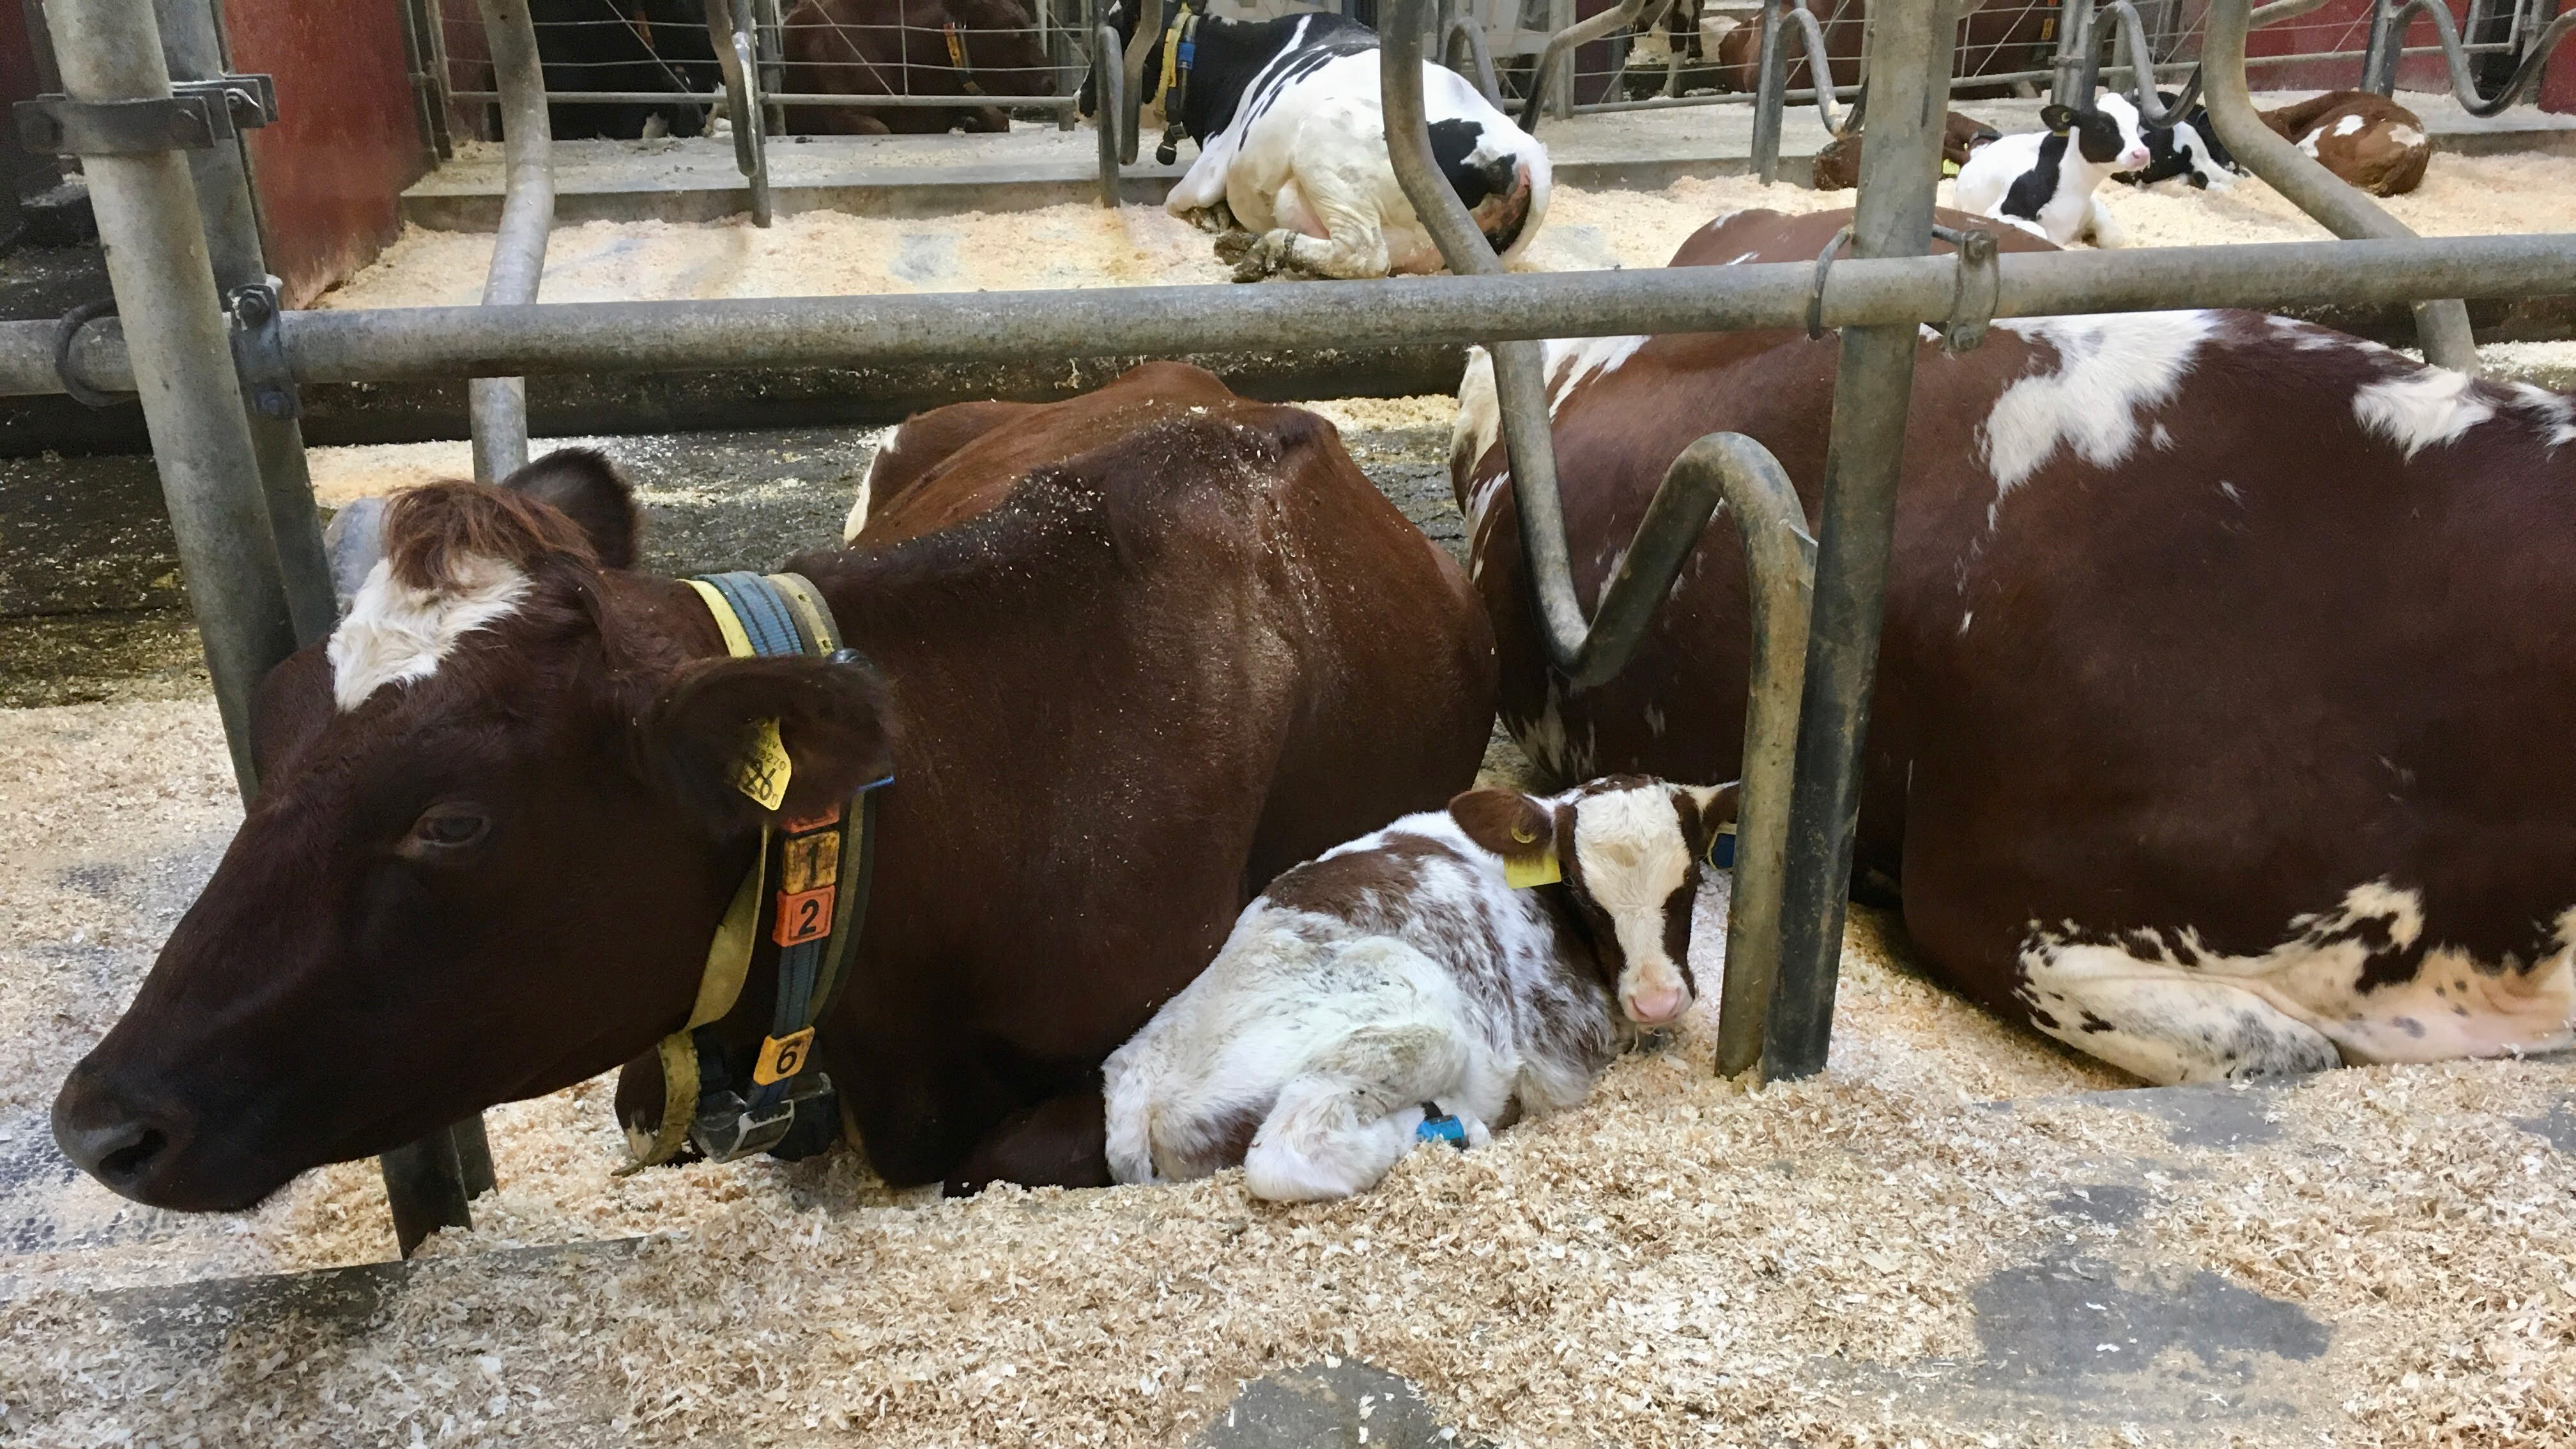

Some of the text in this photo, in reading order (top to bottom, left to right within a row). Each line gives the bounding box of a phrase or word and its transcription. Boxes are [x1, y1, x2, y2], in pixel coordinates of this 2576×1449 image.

[807, 843, 819, 883] 1
[799, 899, 819, 936] 2
[776, 1040, 801, 1074] 6
